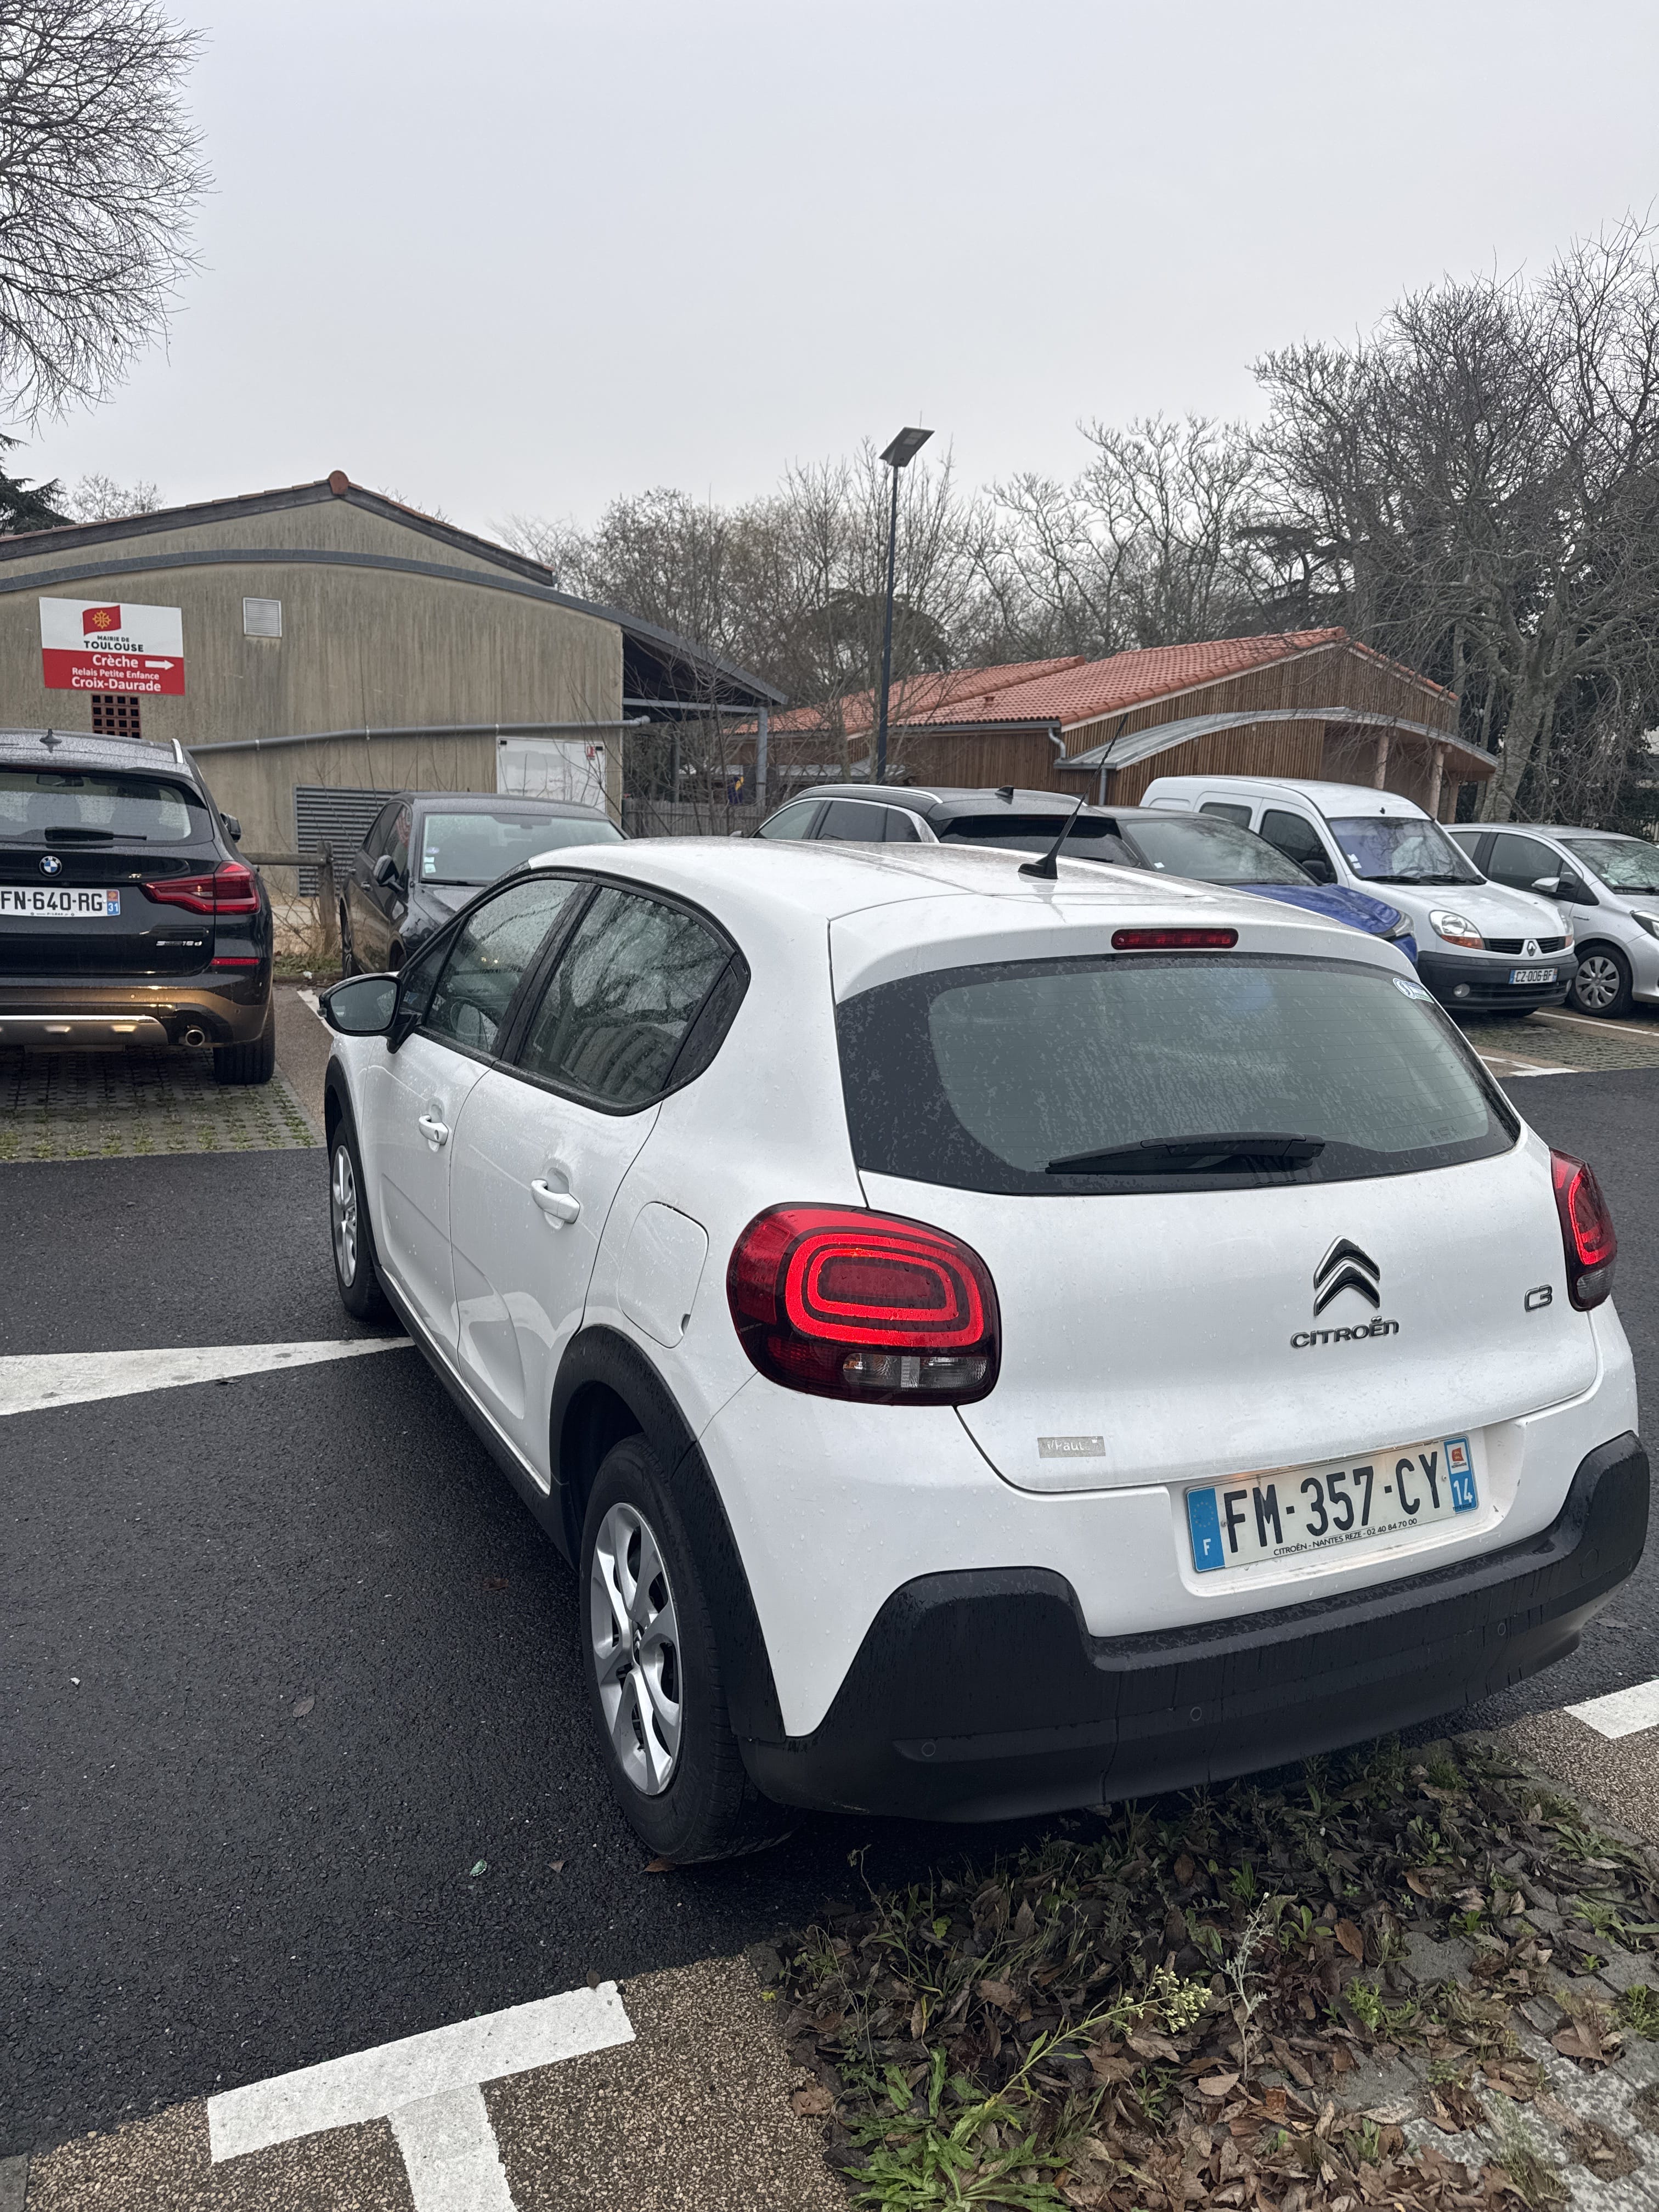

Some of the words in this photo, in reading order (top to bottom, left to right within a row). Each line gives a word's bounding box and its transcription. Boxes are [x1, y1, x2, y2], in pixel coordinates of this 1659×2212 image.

[83, 640, 144, 652] TOULOUSE
[92, 654, 139, 668] Crèche
[72, 667, 98, 676] Relais
[99, 669, 125, 678] Petite
[126, 670, 160, 680] Enfance
[71, 676, 161, 692] Croix-Daurade
[1, 890, 103, 912] FN-640-RG
[108, 902, 119, 912] 31
[1524, 1284, 1553, 1312] C3
[1453, 1477, 1474, 1505] 14
[1223, 1451, 1440, 1554] FM-357-CY
[1203, 1538, 1211, 1556] F
[1273, 1543, 1307, 1556] CITROËN
[1312, 1535, 1344, 1548] NANTES
[1345, 1531, 1362, 1541] REZE
